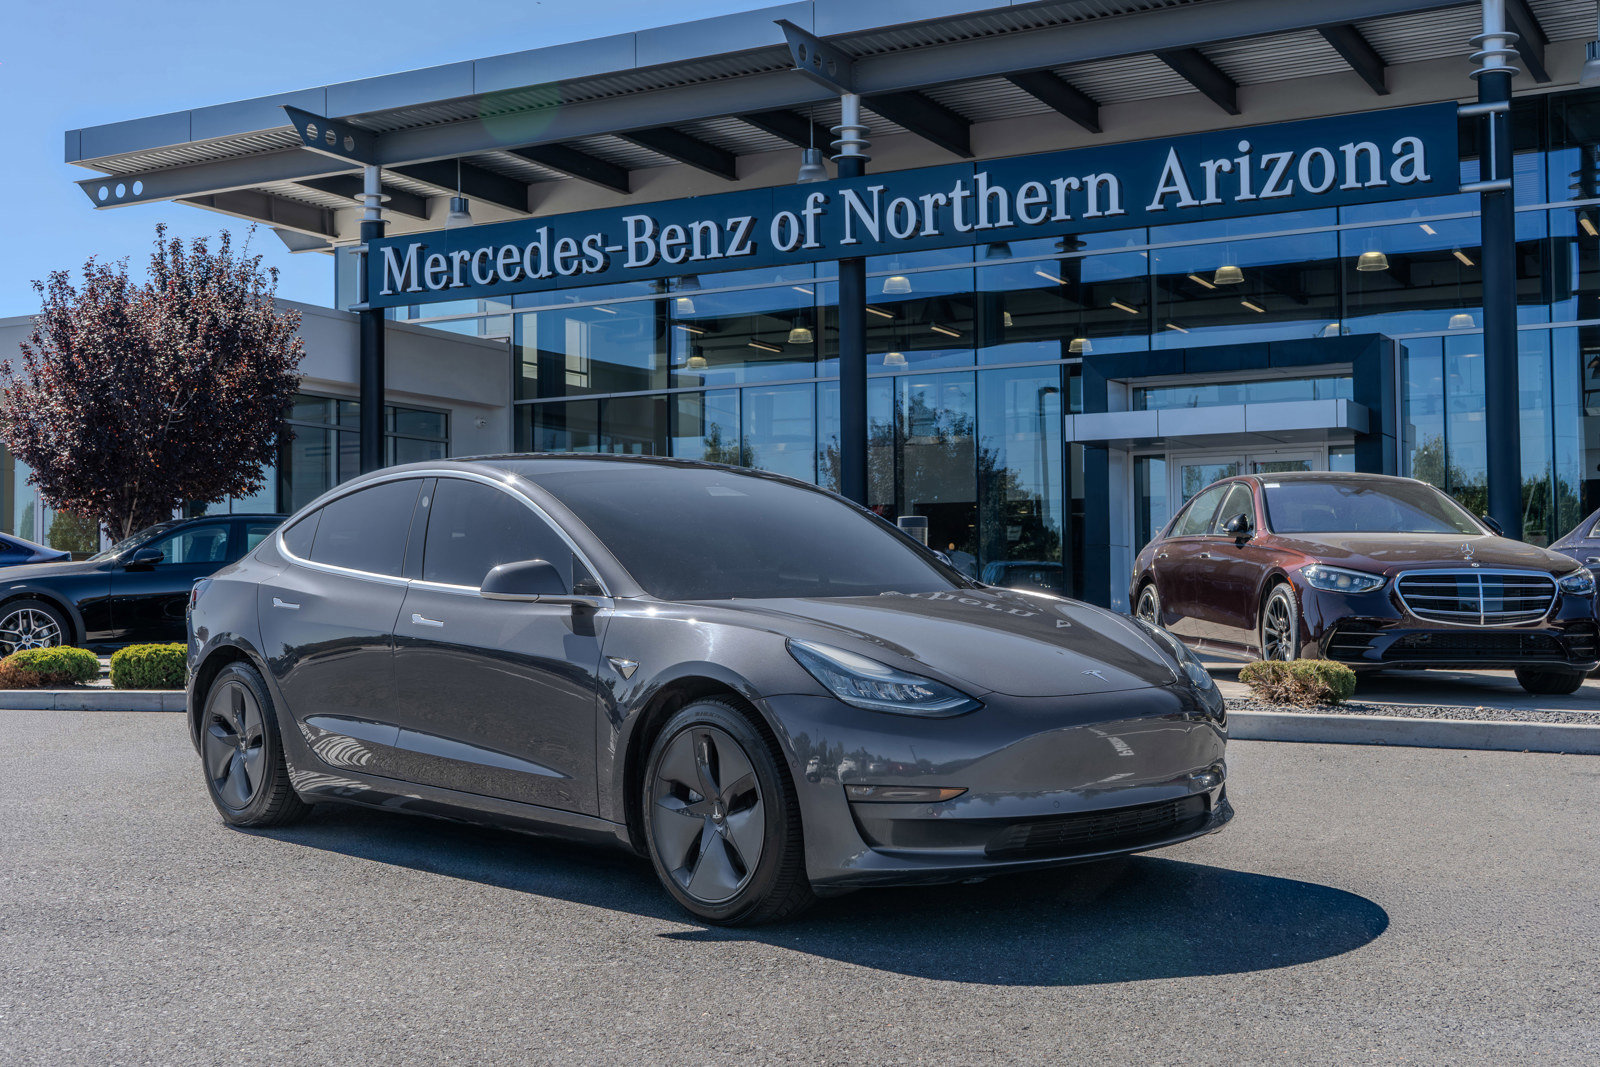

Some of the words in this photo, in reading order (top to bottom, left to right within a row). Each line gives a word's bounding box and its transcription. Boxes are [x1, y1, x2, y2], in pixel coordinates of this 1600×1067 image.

[380, 214, 752, 295] Mercedes-Benz
[770, 192, 825, 252] of
[838, 171, 1125, 245] Northern
[1145, 136, 1431, 211] Arizona
